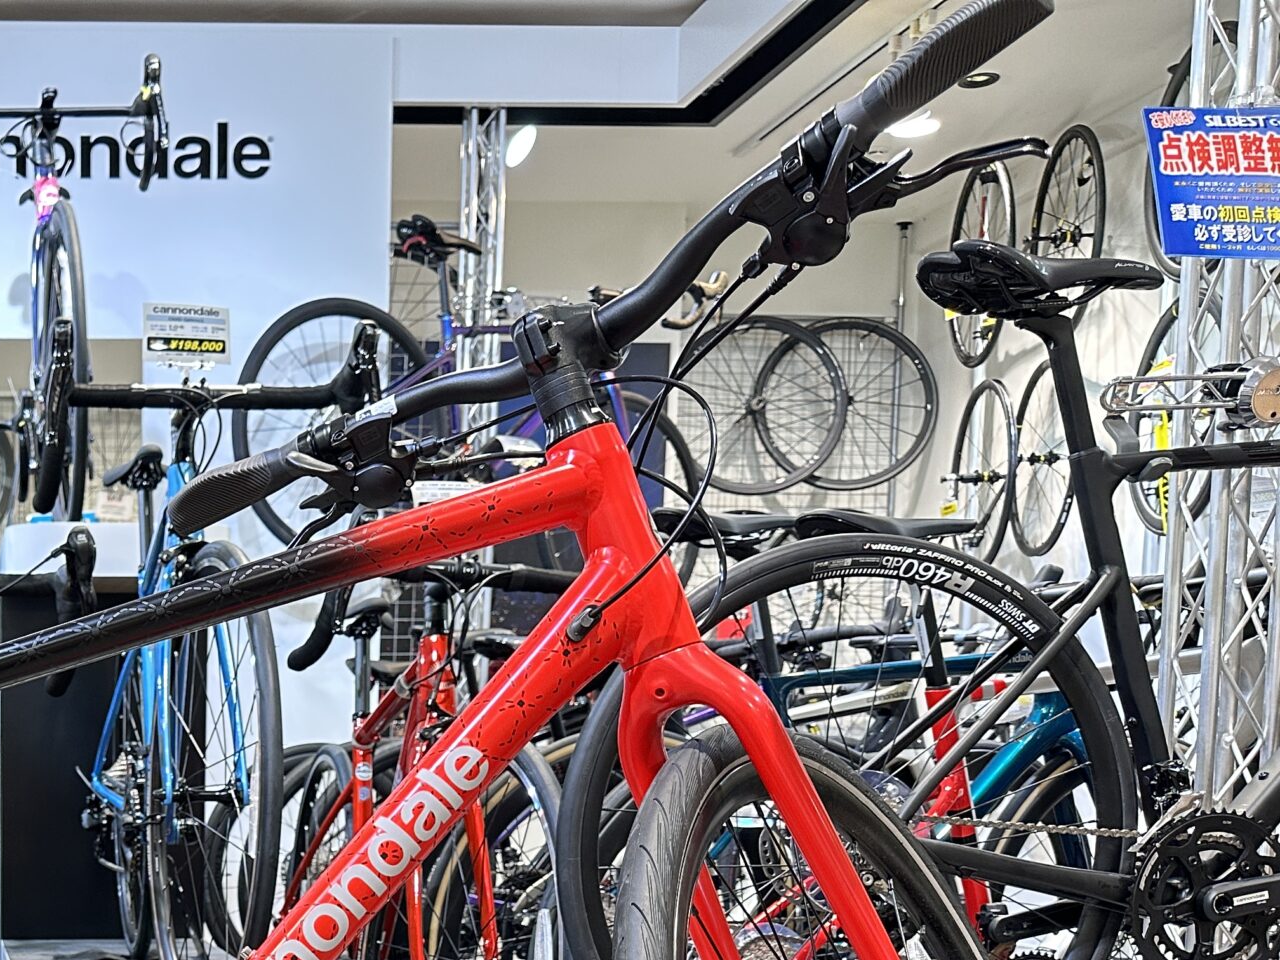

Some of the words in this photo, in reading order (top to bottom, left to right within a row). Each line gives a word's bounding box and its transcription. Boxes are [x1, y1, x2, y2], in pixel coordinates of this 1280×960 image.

[1203, 114, 1267, 128] SILBEST
[152, 305, 221, 317] cannondale
[169, 339, 224, 352] ¥198,000
[997, 598, 1028, 622] SWISS
